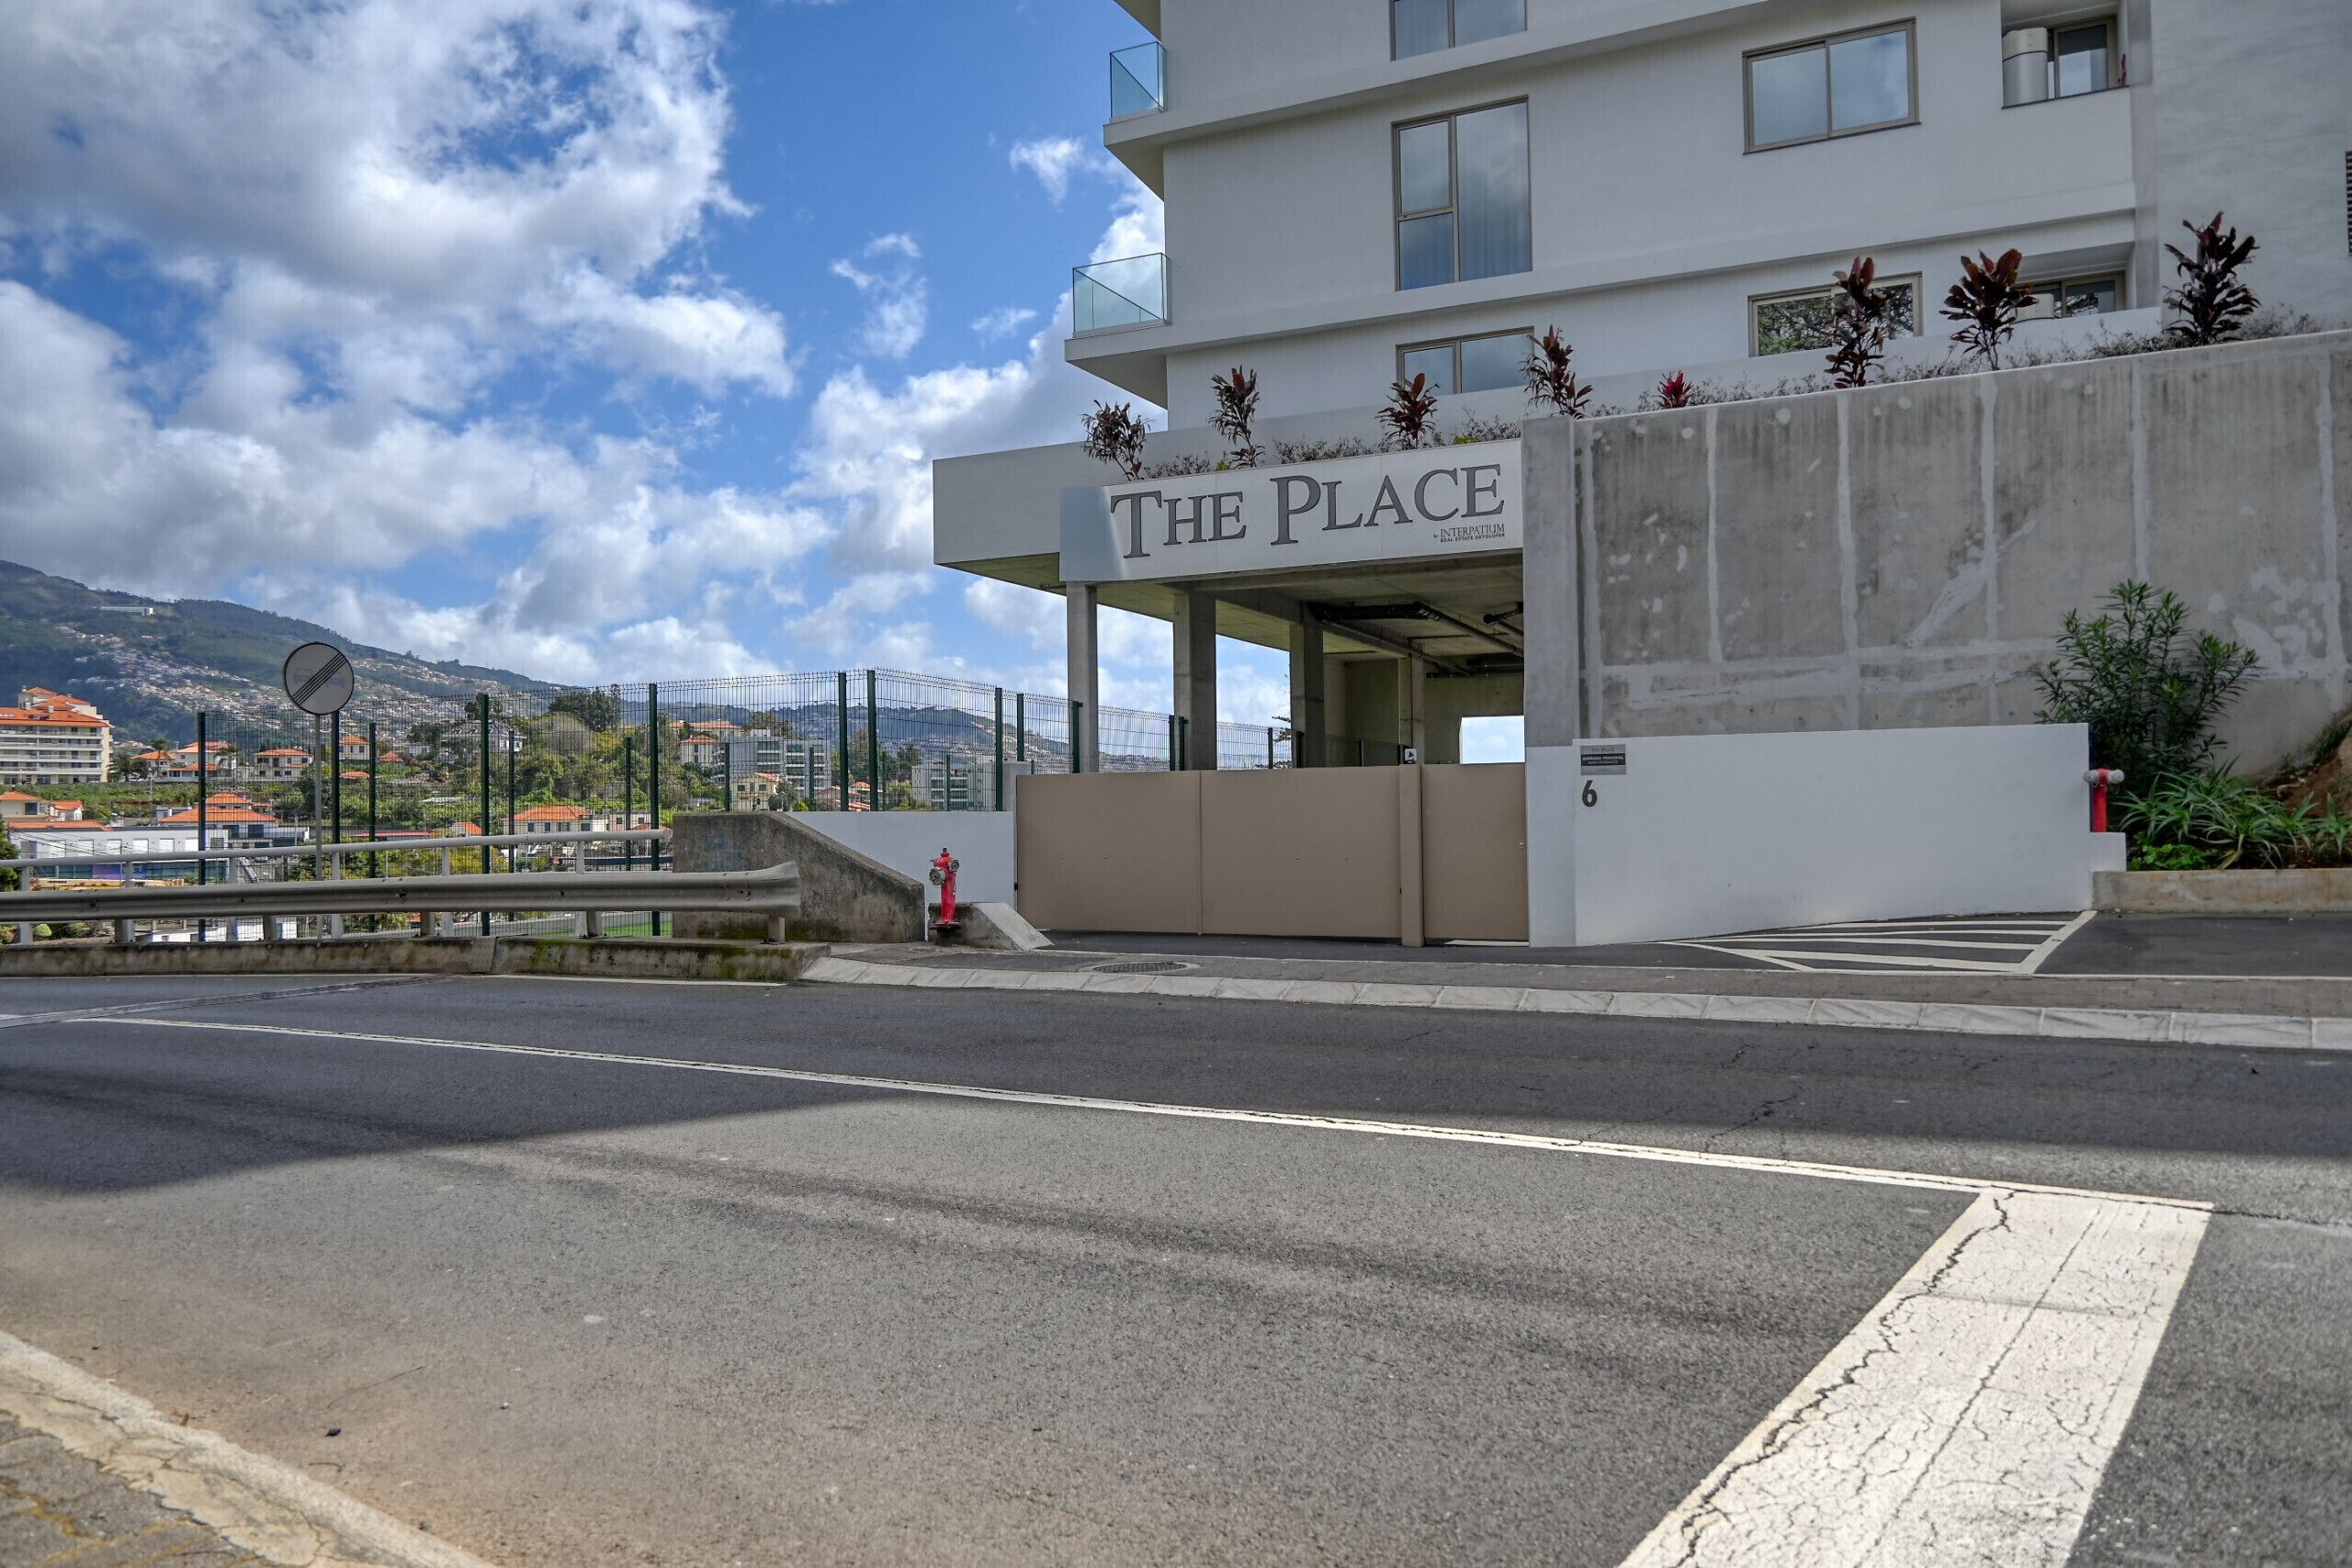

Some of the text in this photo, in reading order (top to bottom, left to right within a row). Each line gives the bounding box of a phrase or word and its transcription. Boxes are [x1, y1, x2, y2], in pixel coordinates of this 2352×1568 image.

[1111, 464, 1505, 558] THE PLACE
[1441, 524, 1505, 537] INTERPATIUM
[1582, 780, 1598, 807] 6
